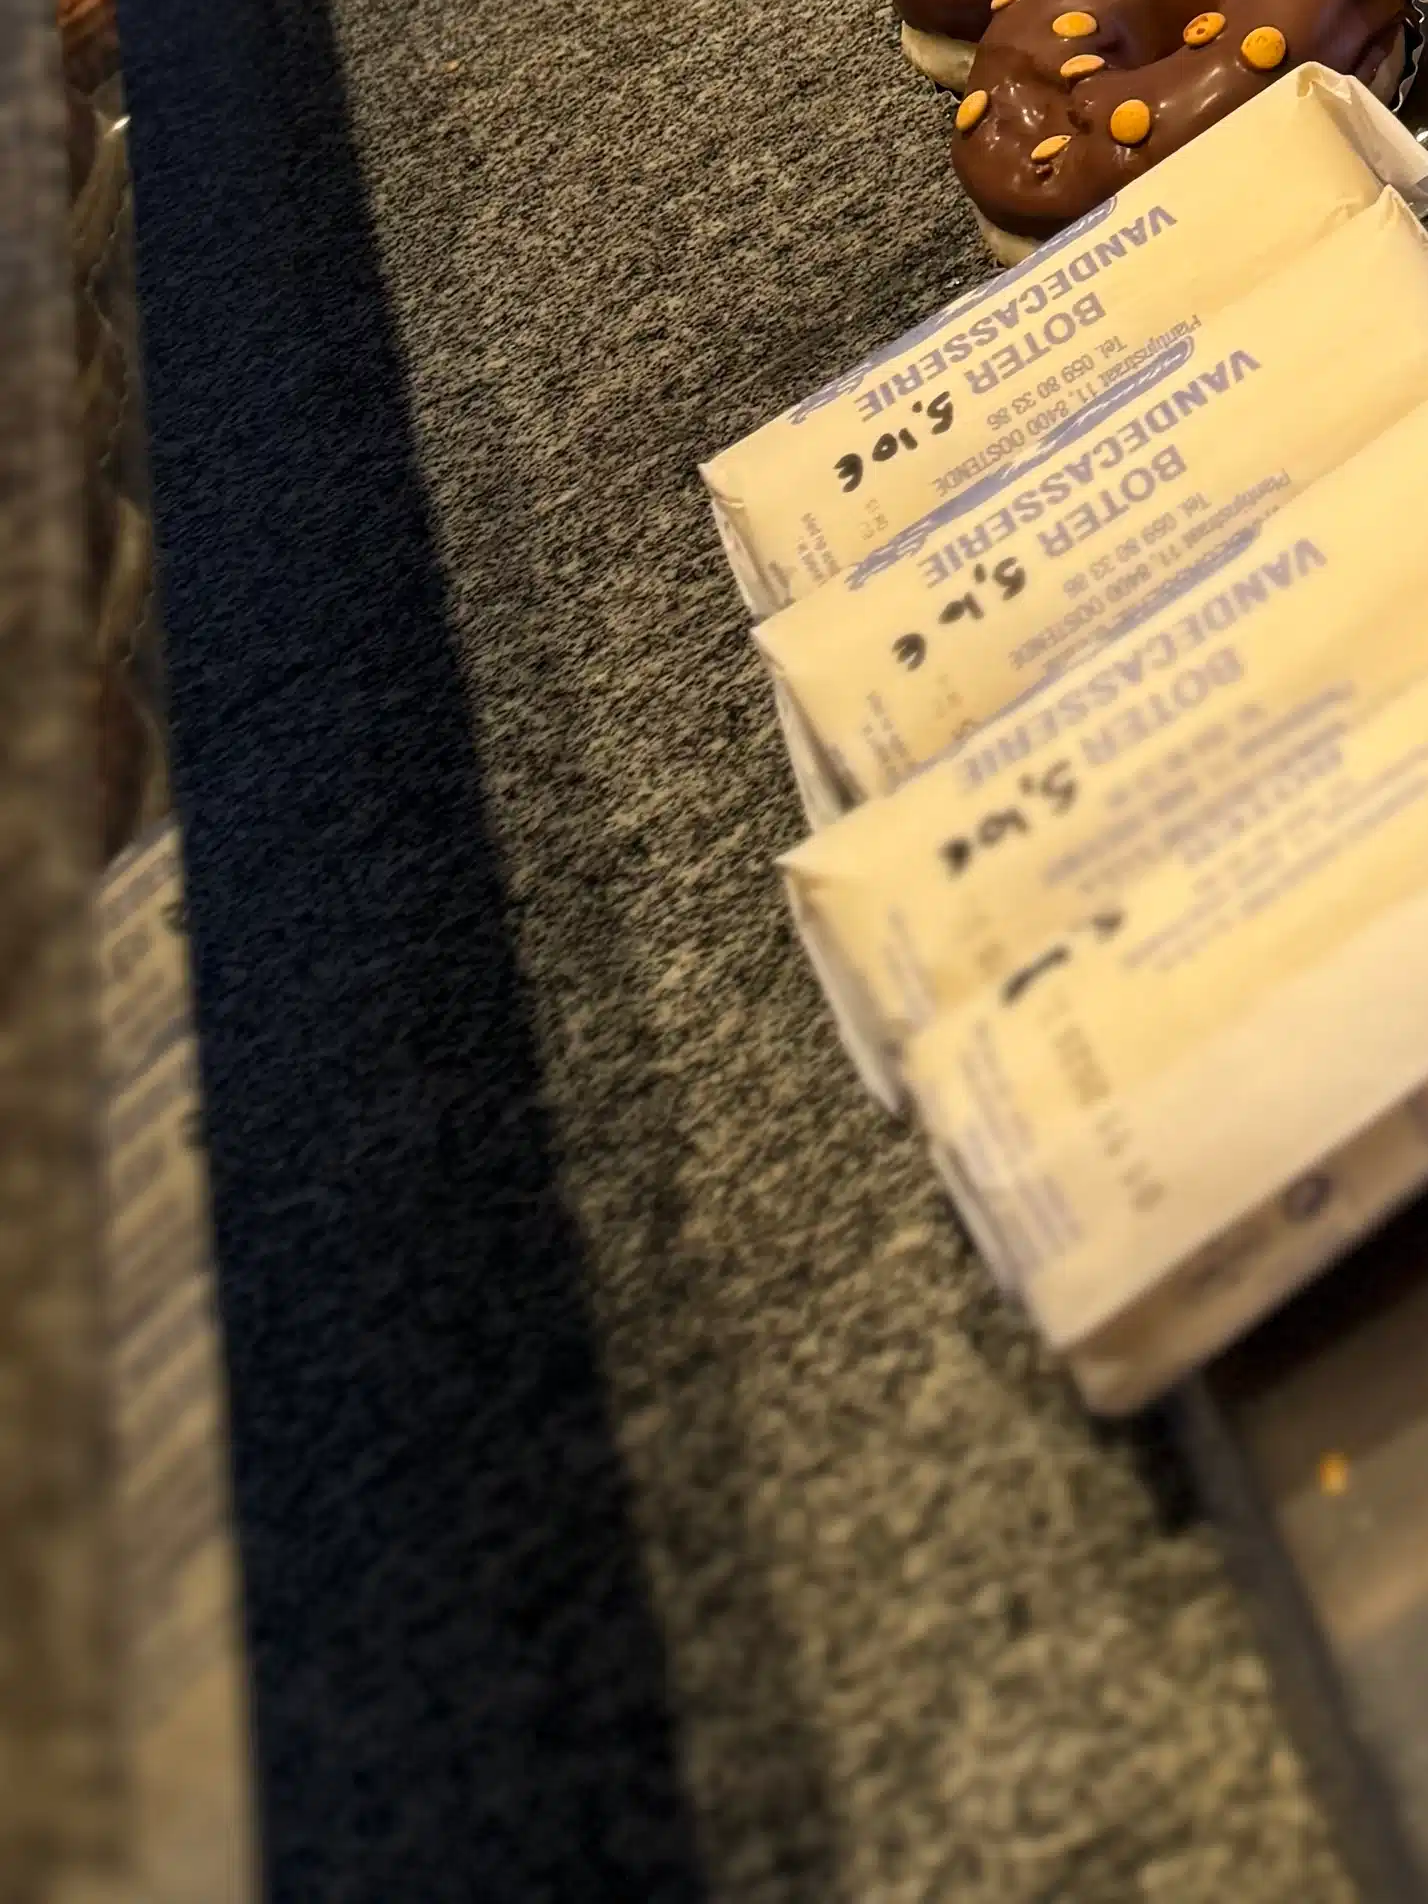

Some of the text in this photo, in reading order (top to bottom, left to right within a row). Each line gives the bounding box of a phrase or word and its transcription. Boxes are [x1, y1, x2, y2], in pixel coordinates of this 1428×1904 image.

[852, 204, 1178, 423] VANDECASSERIE
[962, 290, 1107, 395] BOTER
[1010, 389, 1037, 416] 33
[1024, 398, 1070, 437] 8400
[1035, 374, 1062, 400] 80
[1059, 352, 1095, 384] 059
[915, 348, 1261, 589] VANDECASSERIE
[930, 427, 1027, 498] OOSTENDE
[1034, 442, 1188, 559] BOTER
[954, 536, 1329, 789] VANDECASSERIE
[1078, 645, 1245, 769] BOTER
